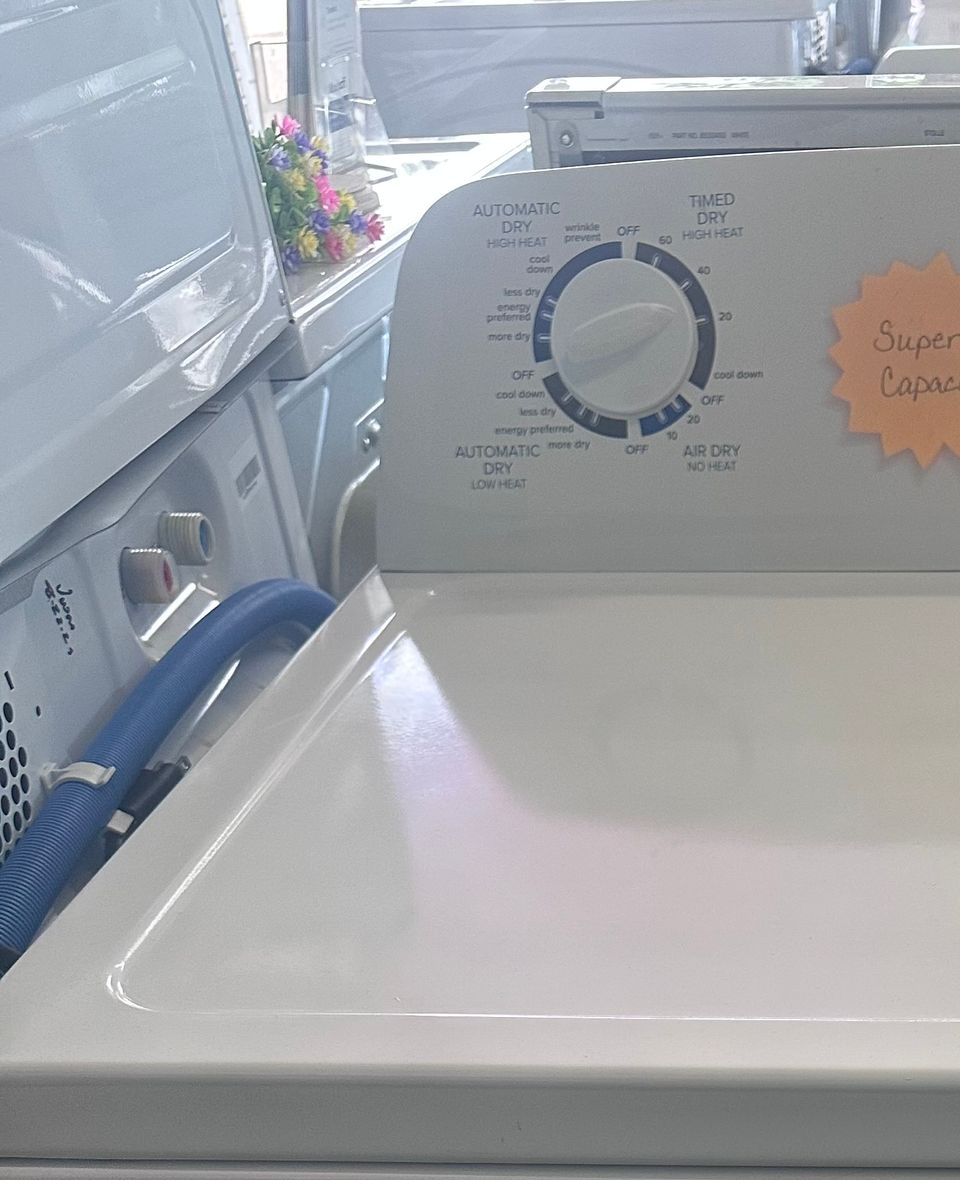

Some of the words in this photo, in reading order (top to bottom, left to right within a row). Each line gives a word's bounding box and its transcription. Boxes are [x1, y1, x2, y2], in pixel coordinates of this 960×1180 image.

[689, 192, 735, 208] TIMED
[473, 201, 561, 218] AUTOMATIC
[697, 210, 728, 225] DRY
[502, 220, 533, 234] DRY
[565, 222, 600, 232] wrinkle
[617, 225, 641, 237] OFF
[564, 233, 601, 244] prevent
[682, 229, 712, 241] HIGH
[714, 226, 744, 239] HEAT
[487, 238, 516, 249] HIGH
[518, 236, 547, 248] HEAT
[529, 255, 550, 264] cool
[526, 265, 554, 274] down
[697, 265, 711, 275] 40
[503, 287, 523, 297] less
[525, 287, 541, 299] dry
[496, 303, 531, 314] energy
[486, 312, 531, 324] preferred
[719, 311, 732, 322] 20
[488, 332, 513, 342] more
[514, 331, 531, 343] dry
[512, 370, 535, 381] OFF
[714, 370, 735, 380] cool
[738, 370, 764, 380] down
[495, 390, 517, 400] cool
[518, 390, 546, 400] down
[700, 395, 724, 406] OFF
[519, 407, 538, 417] less
[540, 407, 557, 418] dry
[687, 414, 701, 425] 20
[494, 426, 528, 437] energy
[530, 423, 574, 435] preferred
[666, 431, 678, 441] 10
[547, 440, 572, 451] more
[573, 439, 591, 451] dry
[625, 444, 649, 456] OFF
[683, 444, 708, 457] AIR
[710, 444, 741, 458] DRY
[455, 444, 540, 459] AUTOMATIC
[483, 462, 513, 476] DRY
[687, 461, 707, 473] NO
[709, 460, 737, 473] HEAT
[471, 479, 498, 490] LOW
[498, 478, 527, 490] HEAT
